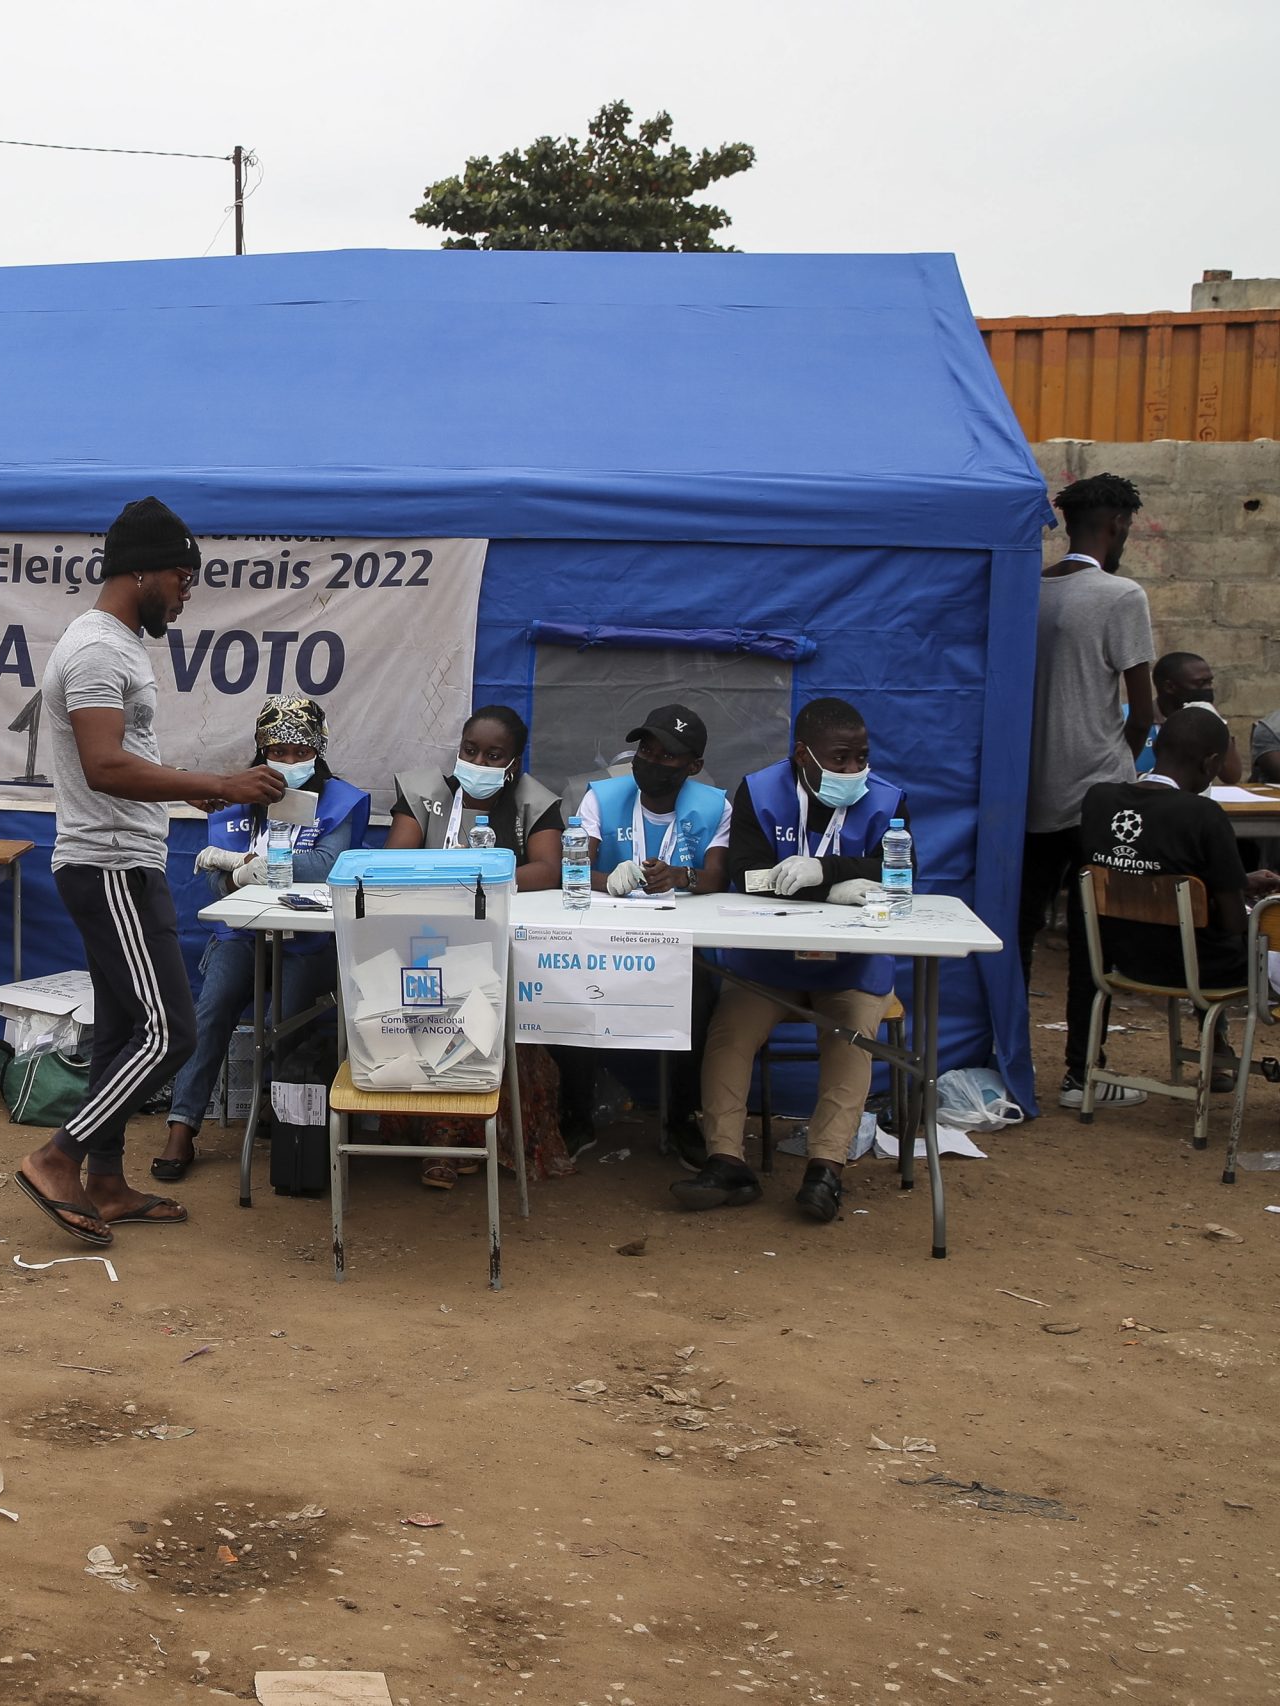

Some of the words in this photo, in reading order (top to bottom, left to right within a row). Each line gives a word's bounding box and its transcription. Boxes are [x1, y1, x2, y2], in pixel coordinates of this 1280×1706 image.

[325, 549, 433, 589] 2022
[166, 628, 345, 696] VOTO
[775, 825, 796, 842] E.G.
[1113, 846, 1138, 859] UEFA
[1092, 852, 1161, 871] CHAMPIONS
[610, 935, 637, 944] Eleições
[537, 953, 581, 970] MESA
[587, 954, 606, 970] DE
[613, 955, 655, 972] VOTO
[405, 975, 438, 998] CNE
[518, 981, 543, 1002] Nº
[585, 985, 605, 999] 3
[381, 1016, 424, 1024] Comissão
[427, 1015, 465, 1024] Nacional
[519, 1023, 542, 1031] LETRA
[381, 1026, 416, 1034] Eleitoral
[422, 1026, 465, 1034] ANGOLA
